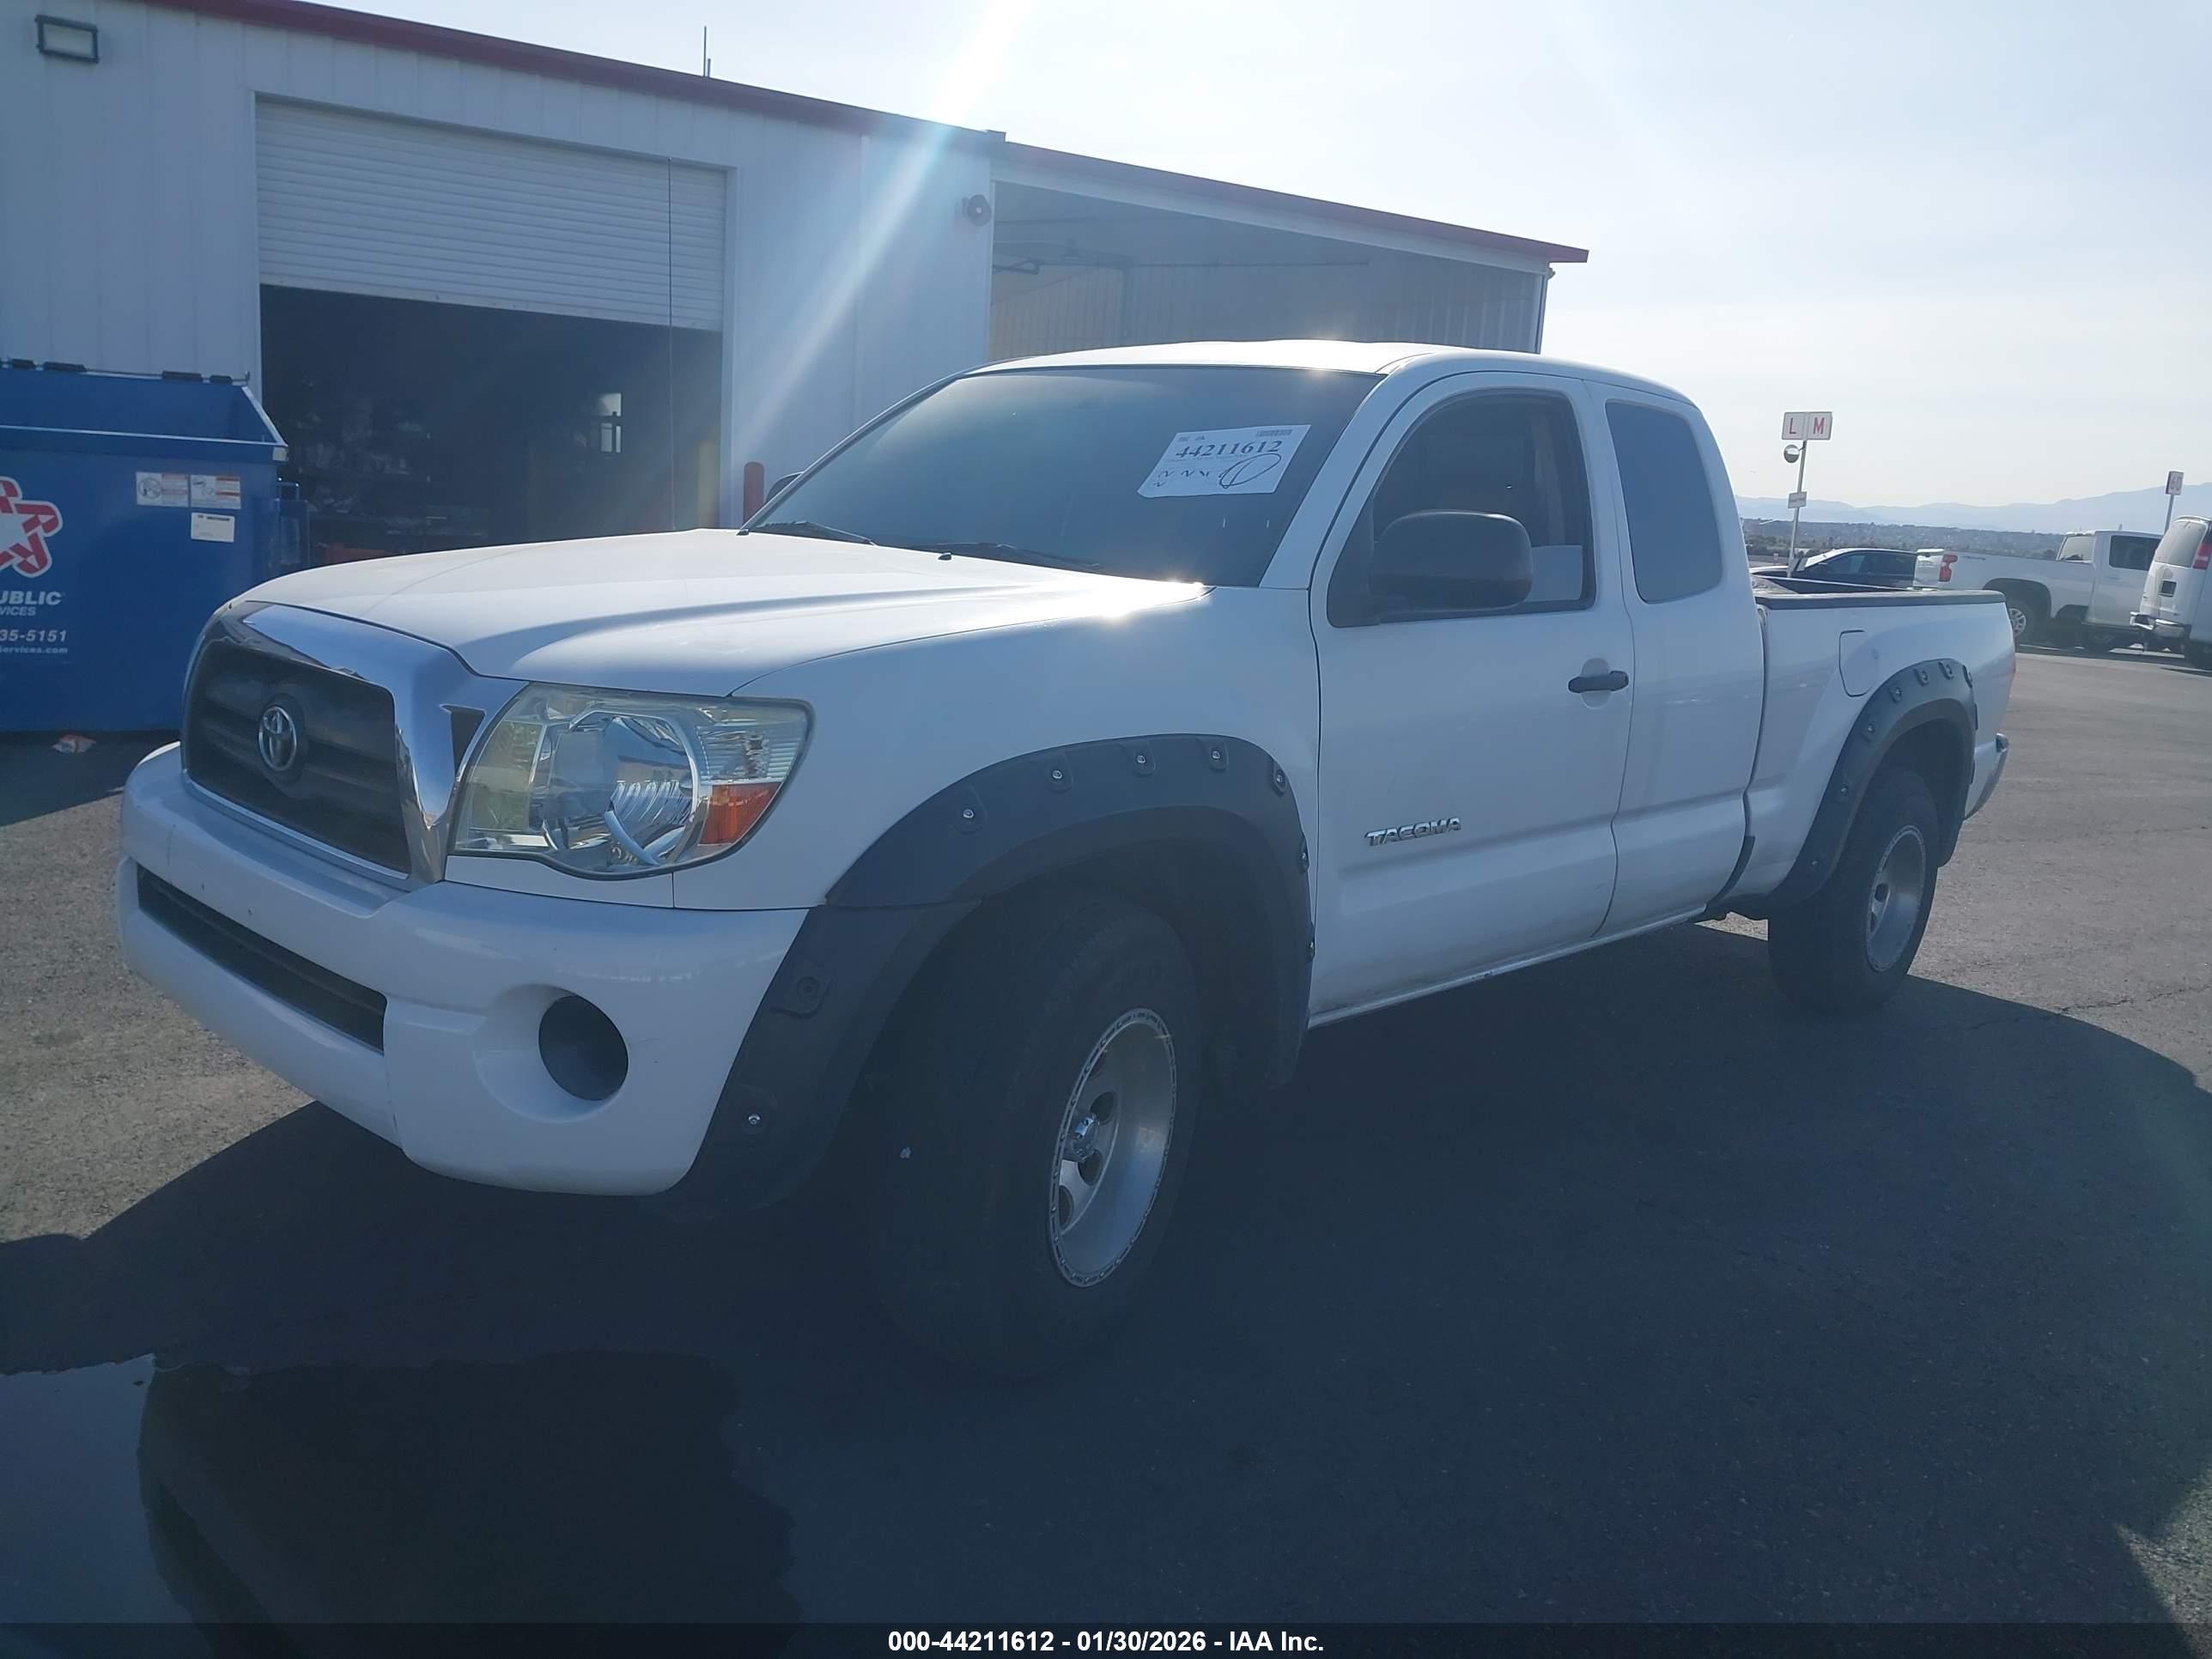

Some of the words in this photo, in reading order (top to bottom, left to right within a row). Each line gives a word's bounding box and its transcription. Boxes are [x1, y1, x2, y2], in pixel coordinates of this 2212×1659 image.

[1789, 417, 1796, 434] L
[1813, 417, 1825, 434] M
[1176, 441, 1283, 459] 44211612
[1364, 817, 1462, 846] TACOMA
